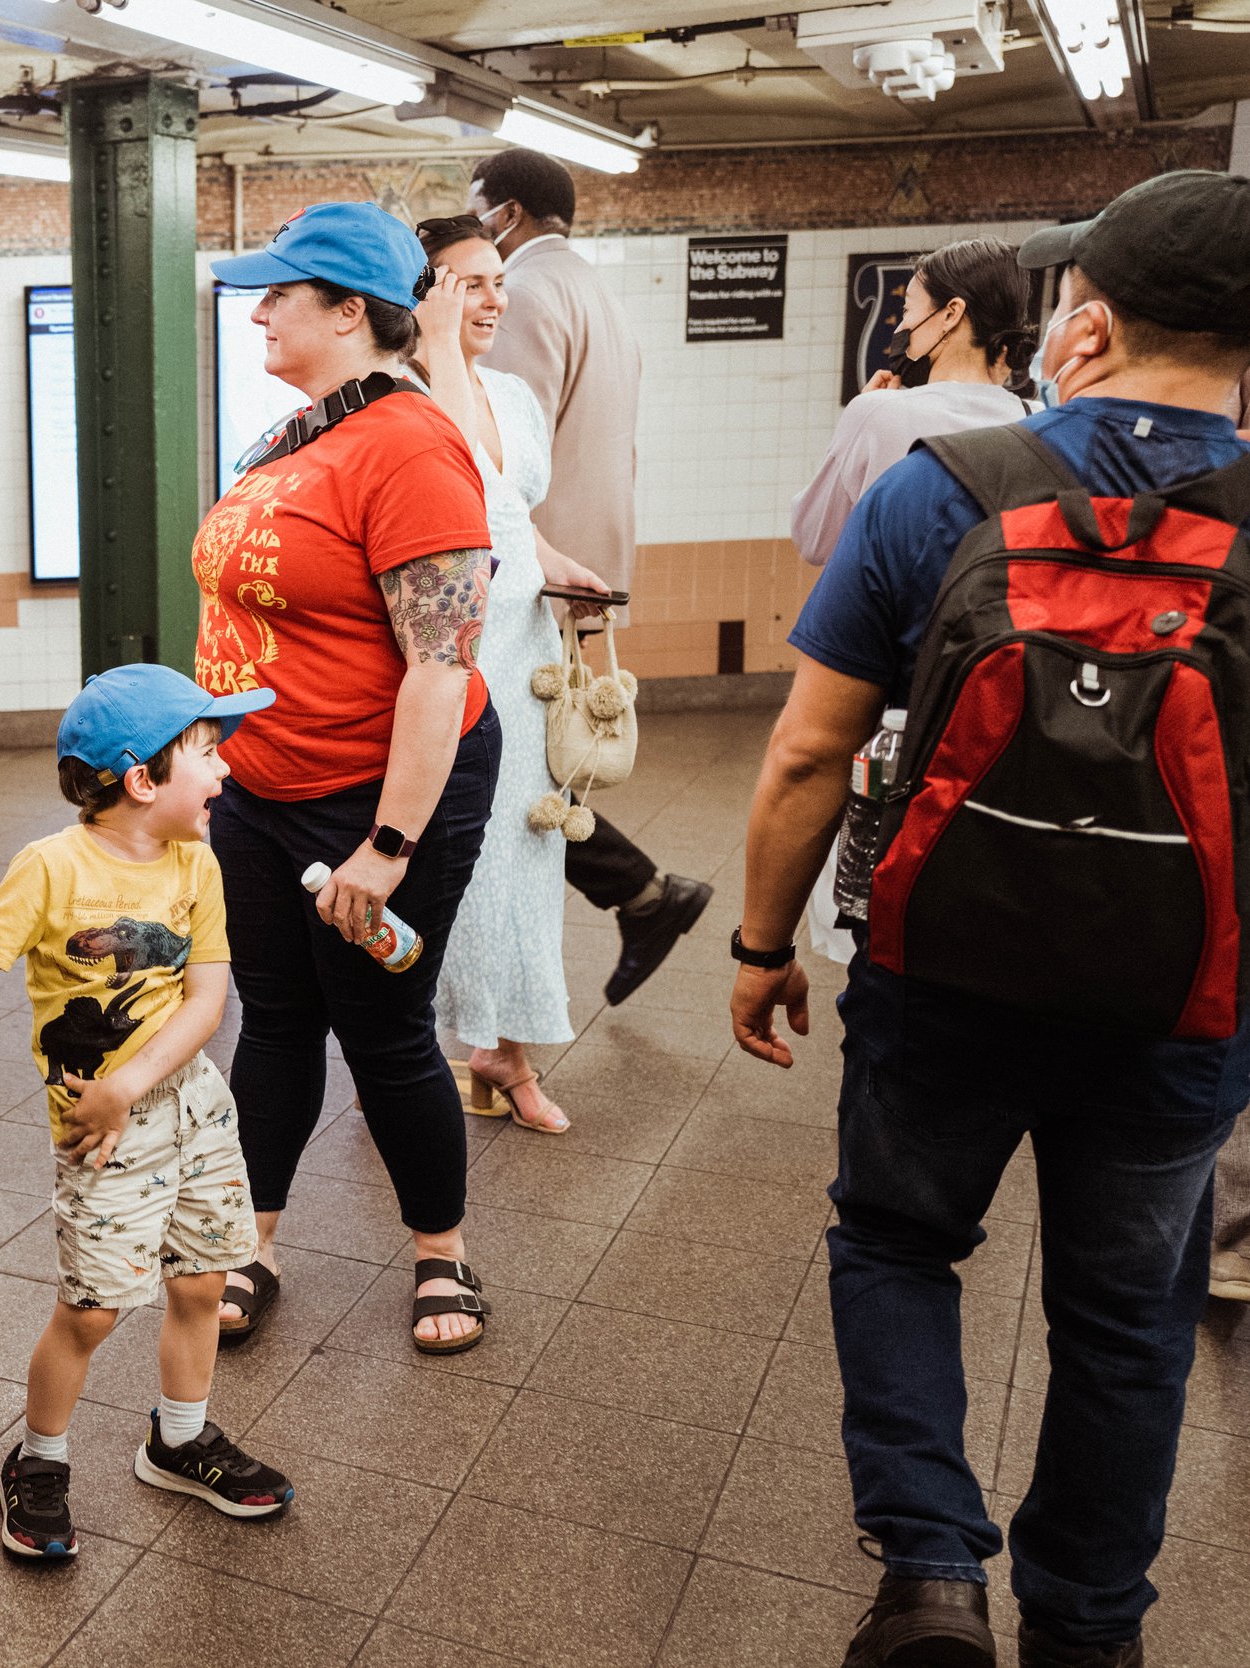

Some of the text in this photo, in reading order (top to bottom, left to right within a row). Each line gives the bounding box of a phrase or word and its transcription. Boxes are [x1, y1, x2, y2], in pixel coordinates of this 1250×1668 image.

[690, 247, 780, 265] Welcome to
[690, 263, 778, 281] the Subway
[241, 528, 281, 549] AND
[239, 551, 280, 576] THE
[68, 891, 113, 909] Cretaceous
